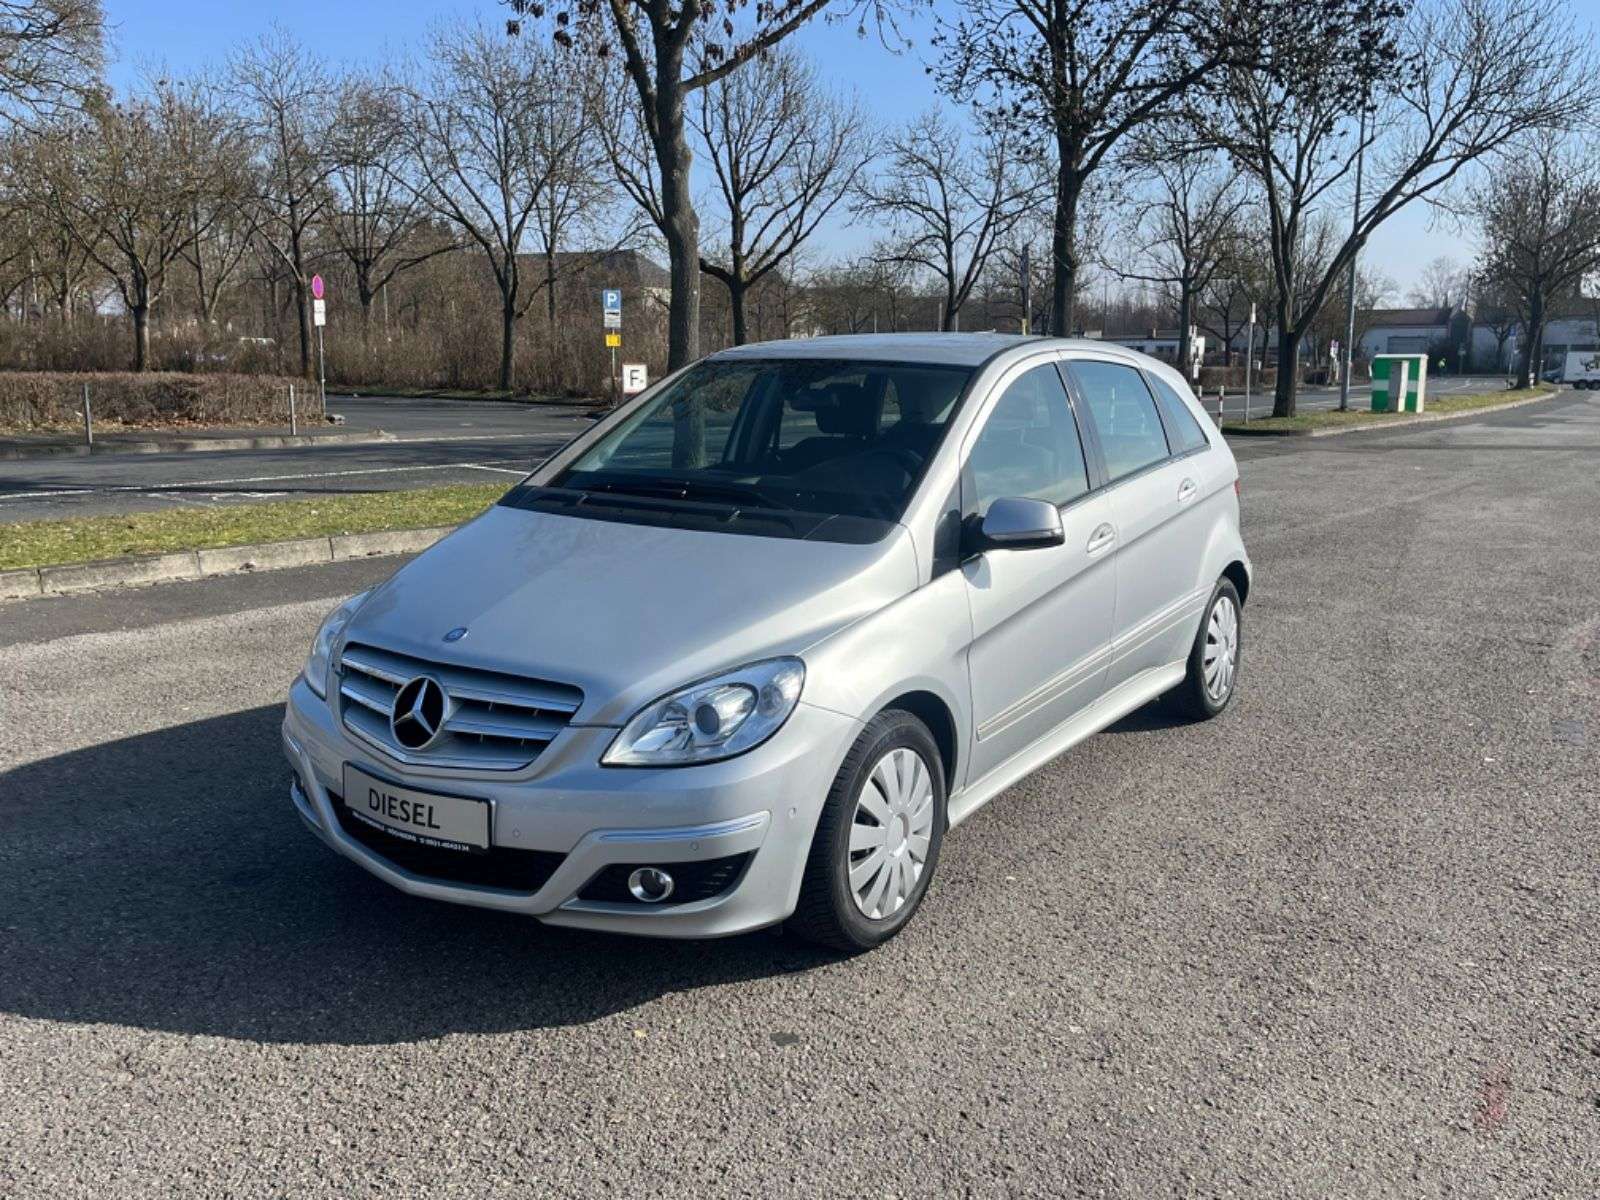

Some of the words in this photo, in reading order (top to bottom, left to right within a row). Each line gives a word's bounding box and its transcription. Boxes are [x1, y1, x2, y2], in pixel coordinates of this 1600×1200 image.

[607, 293, 618, 307] P
[630, 369, 641, 387] F
[369, 788, 440, 829] DIESEL
